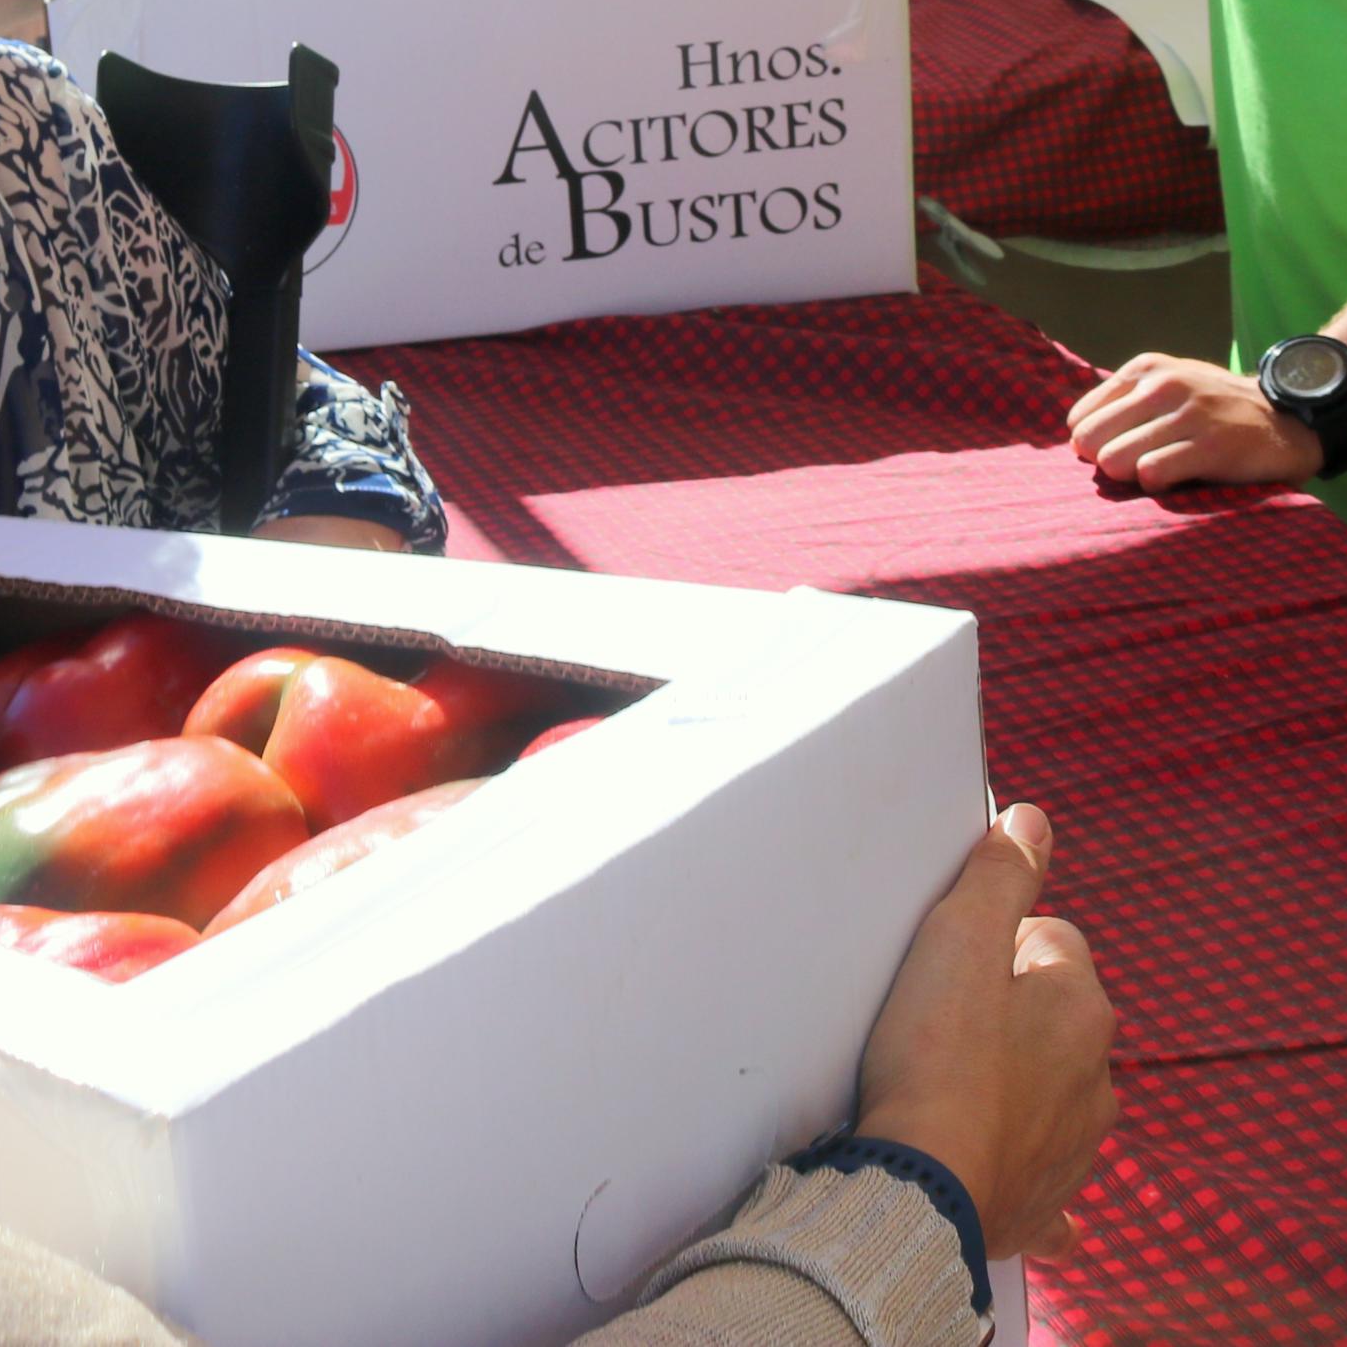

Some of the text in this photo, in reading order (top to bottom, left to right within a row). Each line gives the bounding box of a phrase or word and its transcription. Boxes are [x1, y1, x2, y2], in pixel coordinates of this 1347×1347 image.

[676, 40, 842, 90] Hnos.
[492, 89, 848, 186] ACITORES
[498, 169, 842, 268] de BUSTOS
